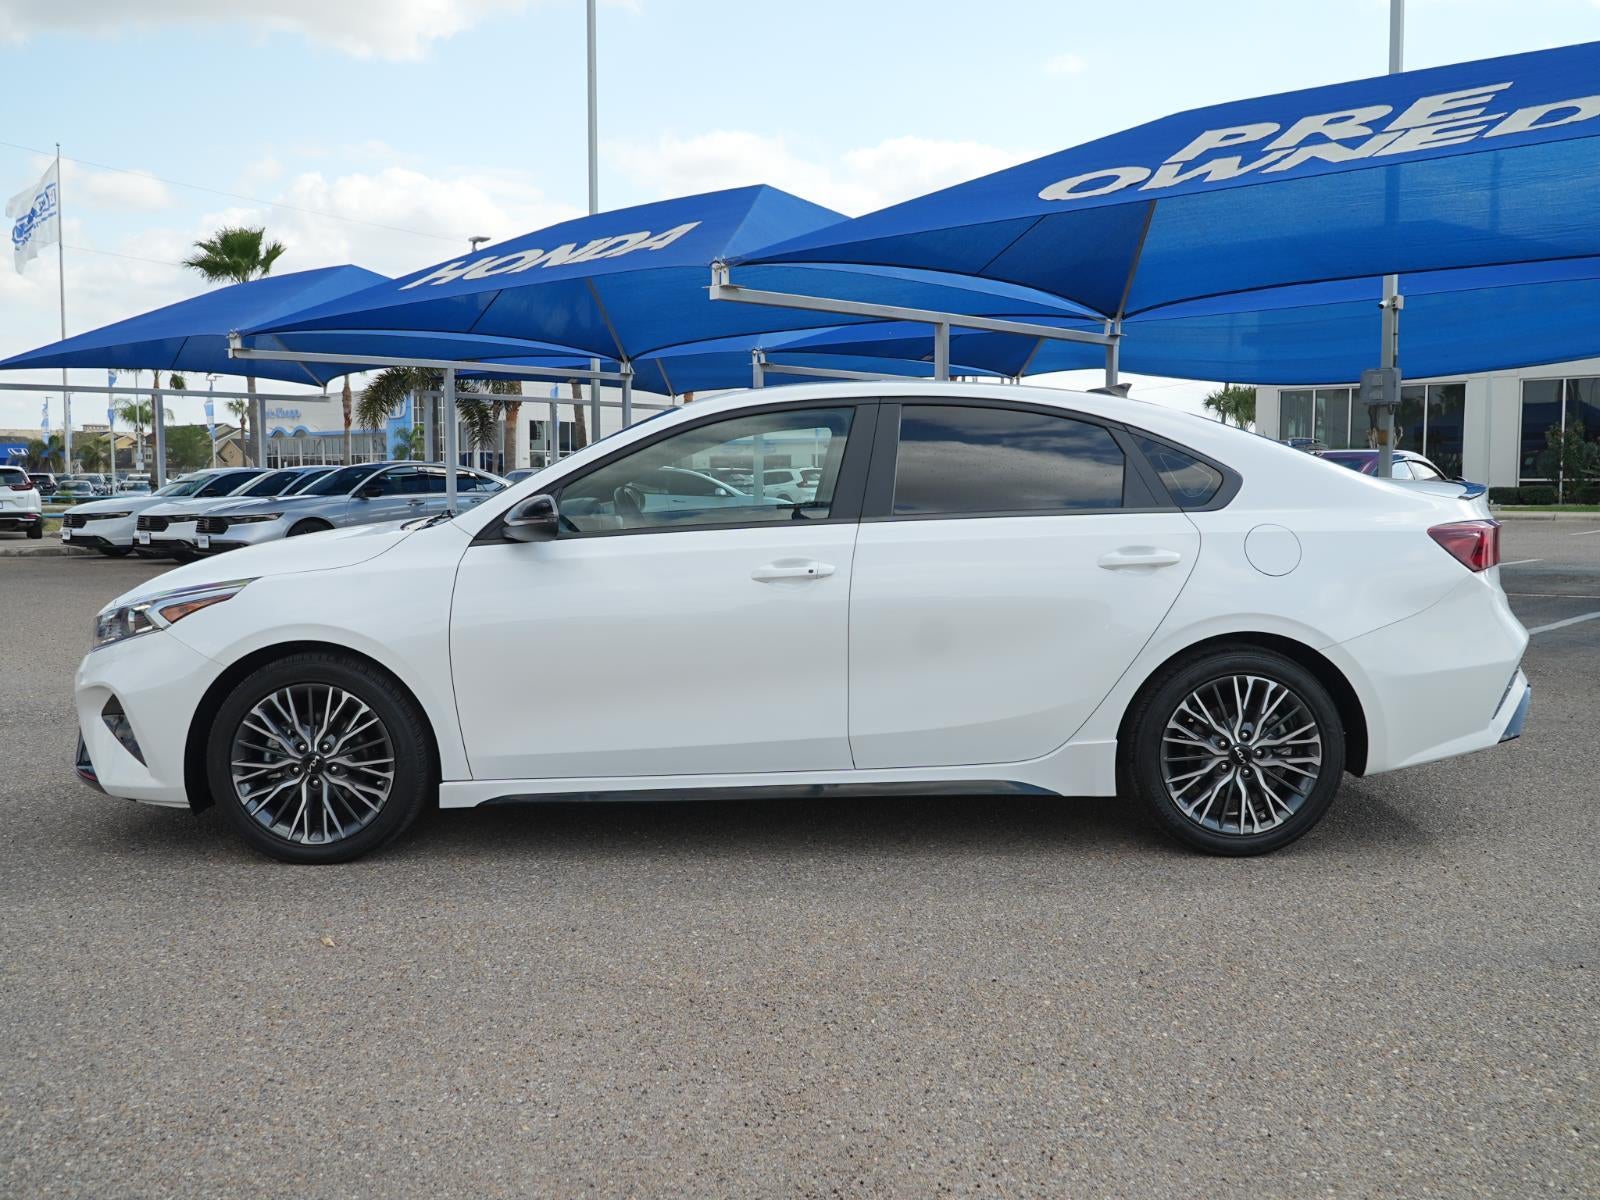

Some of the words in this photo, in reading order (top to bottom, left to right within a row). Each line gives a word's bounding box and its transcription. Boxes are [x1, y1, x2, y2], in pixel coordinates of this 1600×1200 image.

[1037, 94, 1600, 201] OWNED
[1162, 81, 1514, 164] PRE
[398, 220, 702, 291] HONDA
